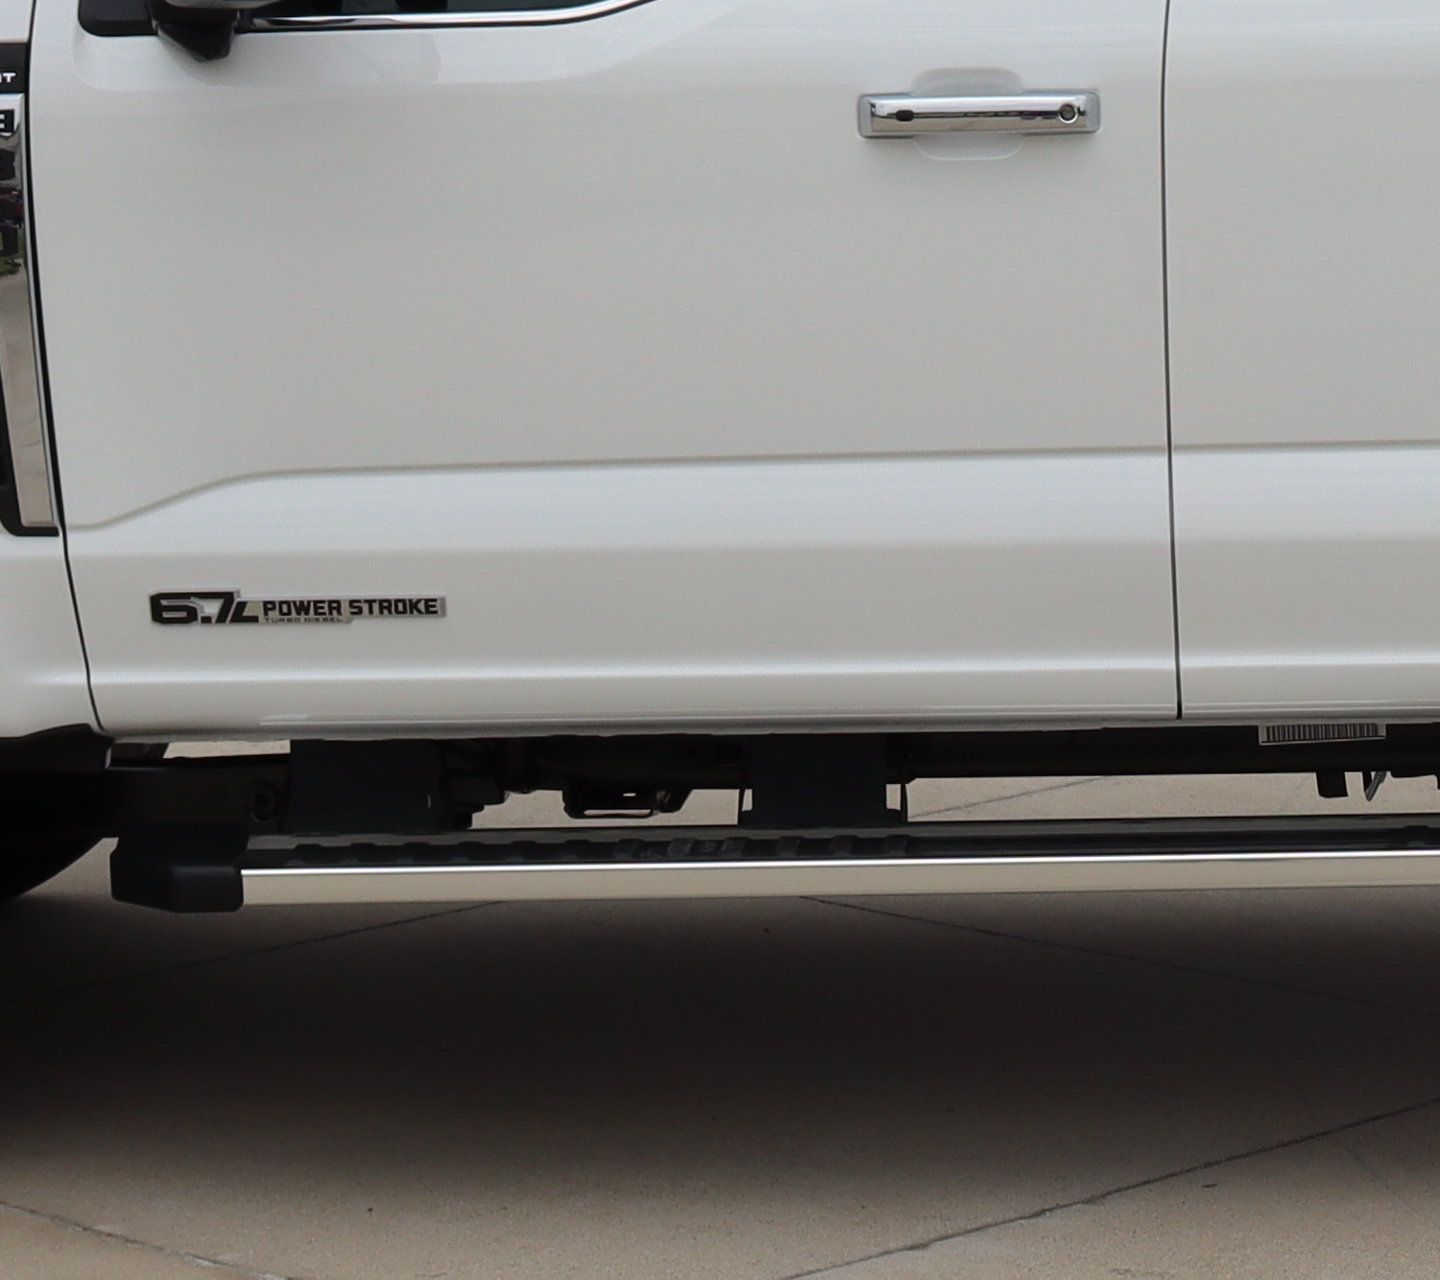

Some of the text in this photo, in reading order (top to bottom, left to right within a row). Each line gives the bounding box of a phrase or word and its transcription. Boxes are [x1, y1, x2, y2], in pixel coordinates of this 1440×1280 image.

[149, 591, 439, 625] 6.7L POWER STROKE
